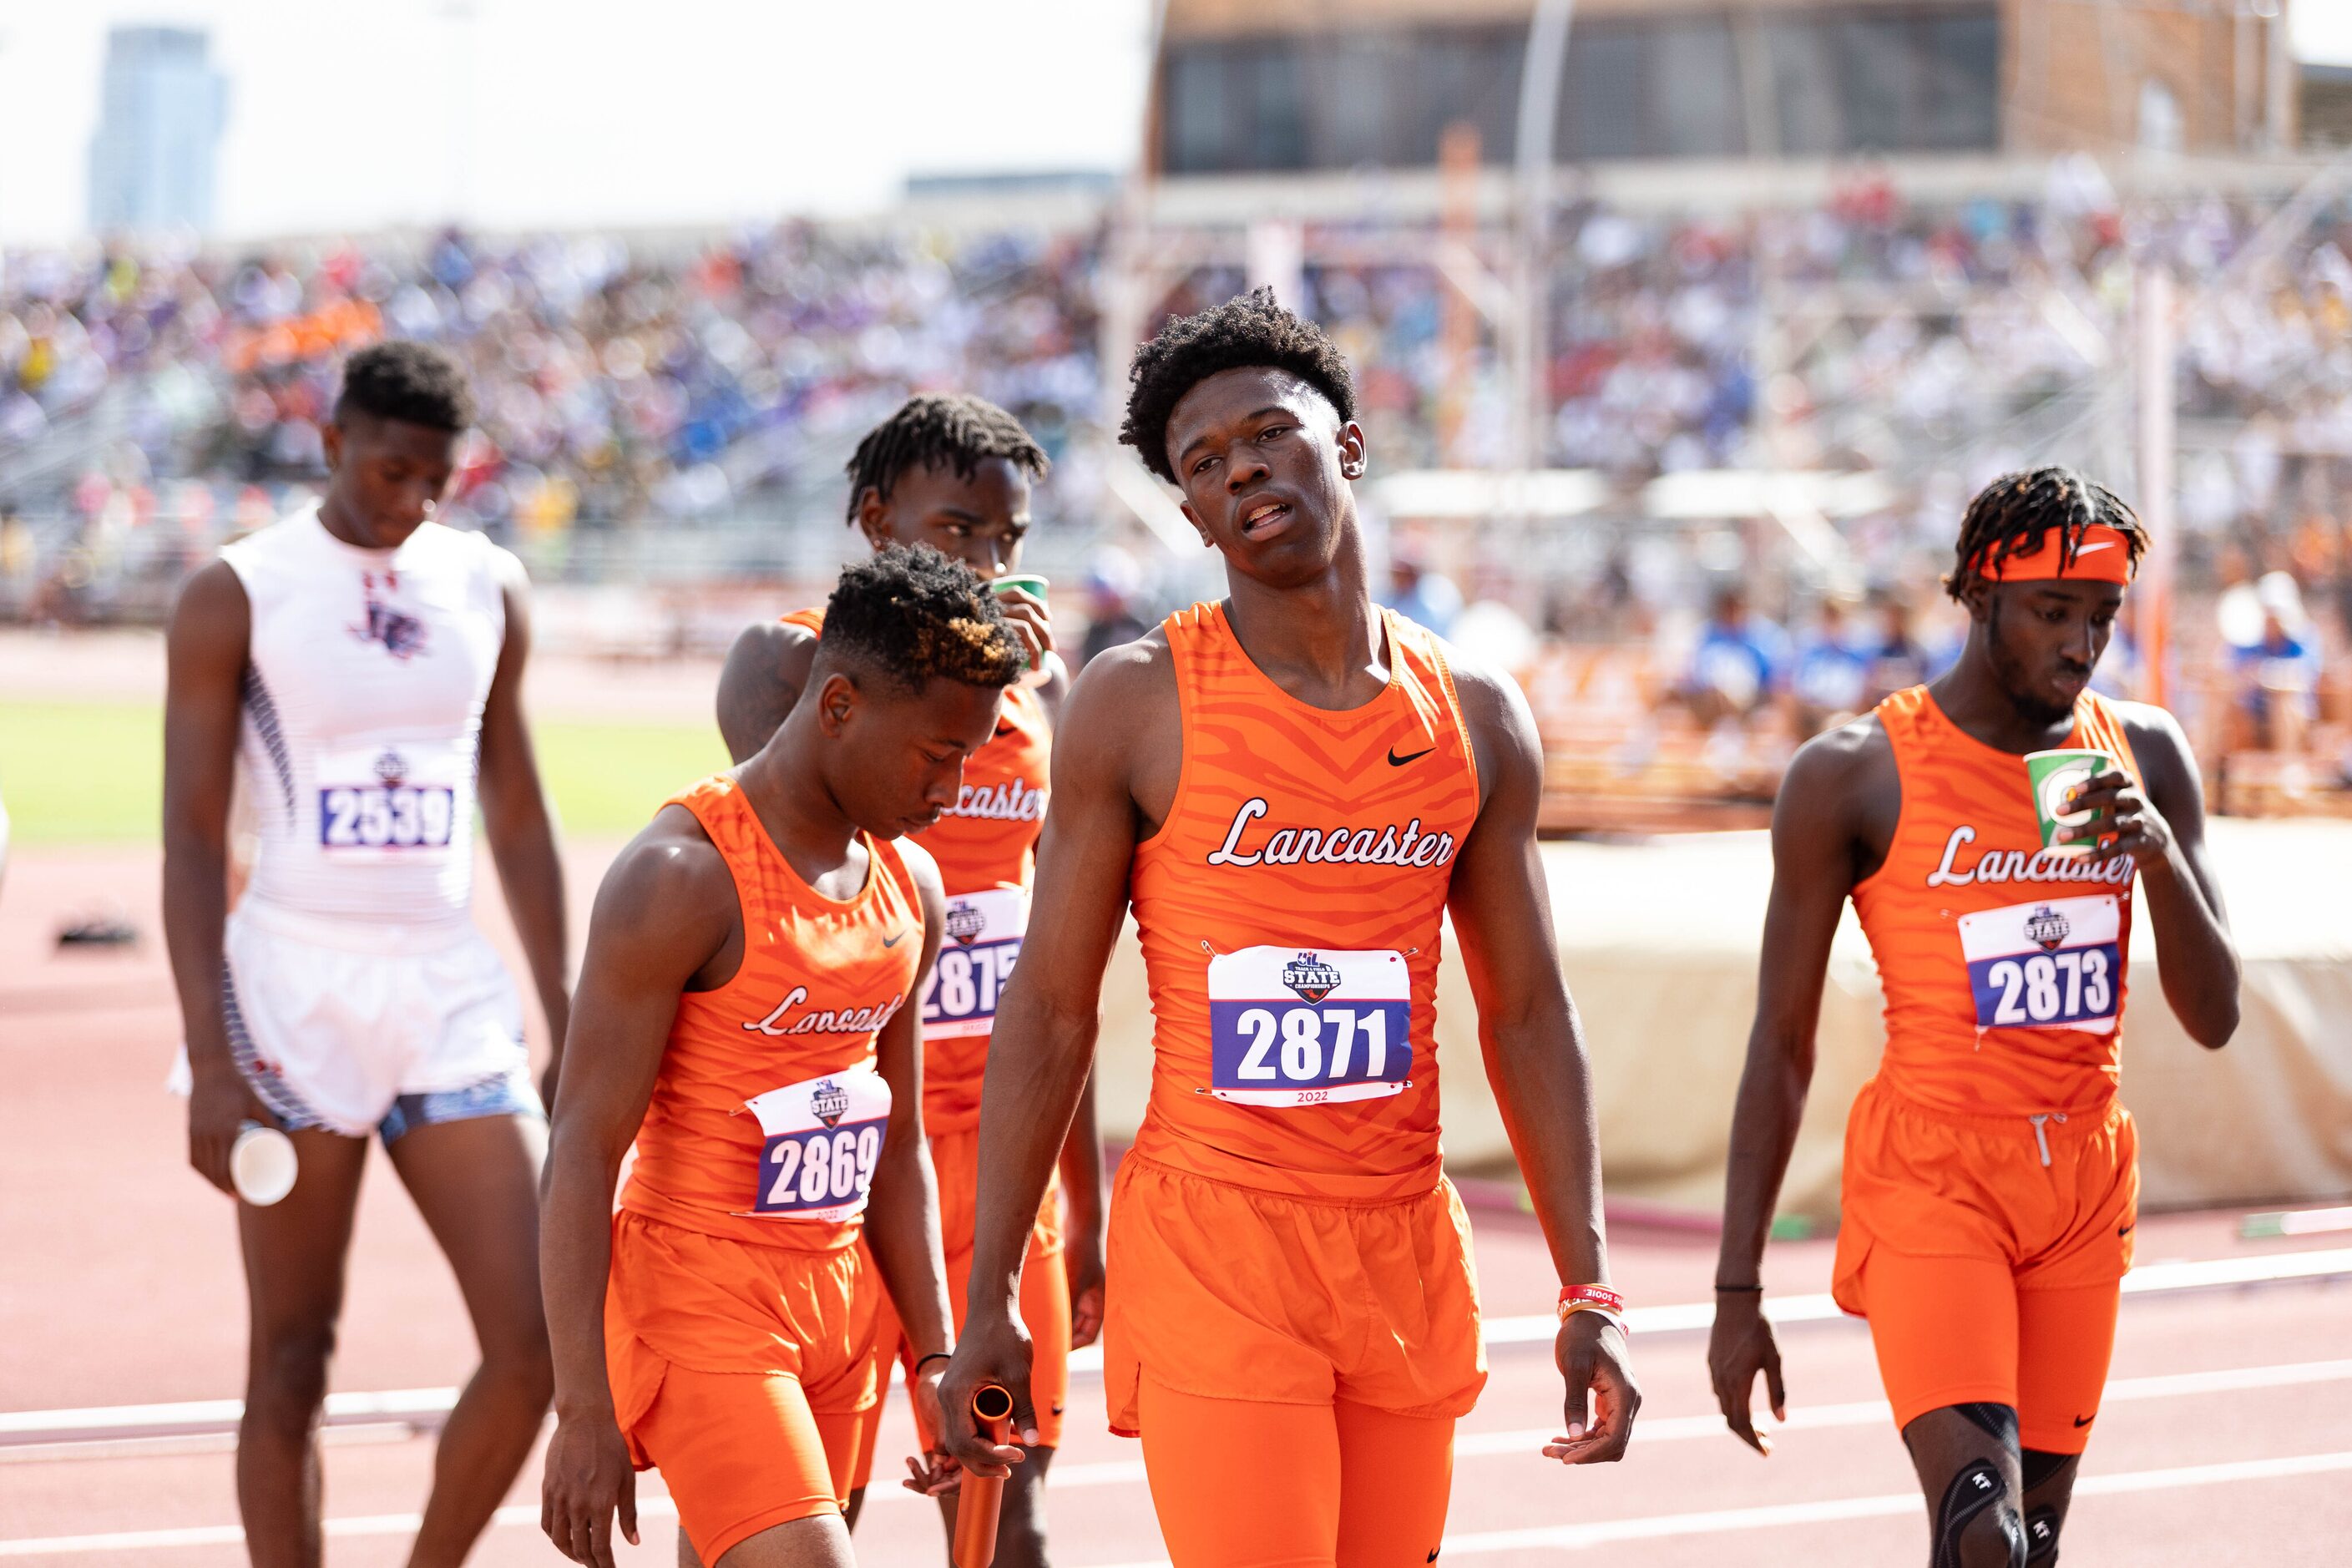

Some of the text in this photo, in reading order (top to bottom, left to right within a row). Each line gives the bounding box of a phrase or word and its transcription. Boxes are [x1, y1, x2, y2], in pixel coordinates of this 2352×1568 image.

[326, 787, 451, 846] 2539
[1207, 797, 1454, 867] Lancaster
[1283, 970, 1340, 984] STATE
[1988, 948, 2111, 1025] 2873
[1237, 1007, 1388, 1081] 2871
[1297, 1090, 1328, 1102] 2022
[766, 1125, 879, 1205] 2869
[1586, 1288, 1613, 1302] SOOIE
[1972, 1472, 1992, 1490] KT
[2033, 1520, 2051, 1540] KT
